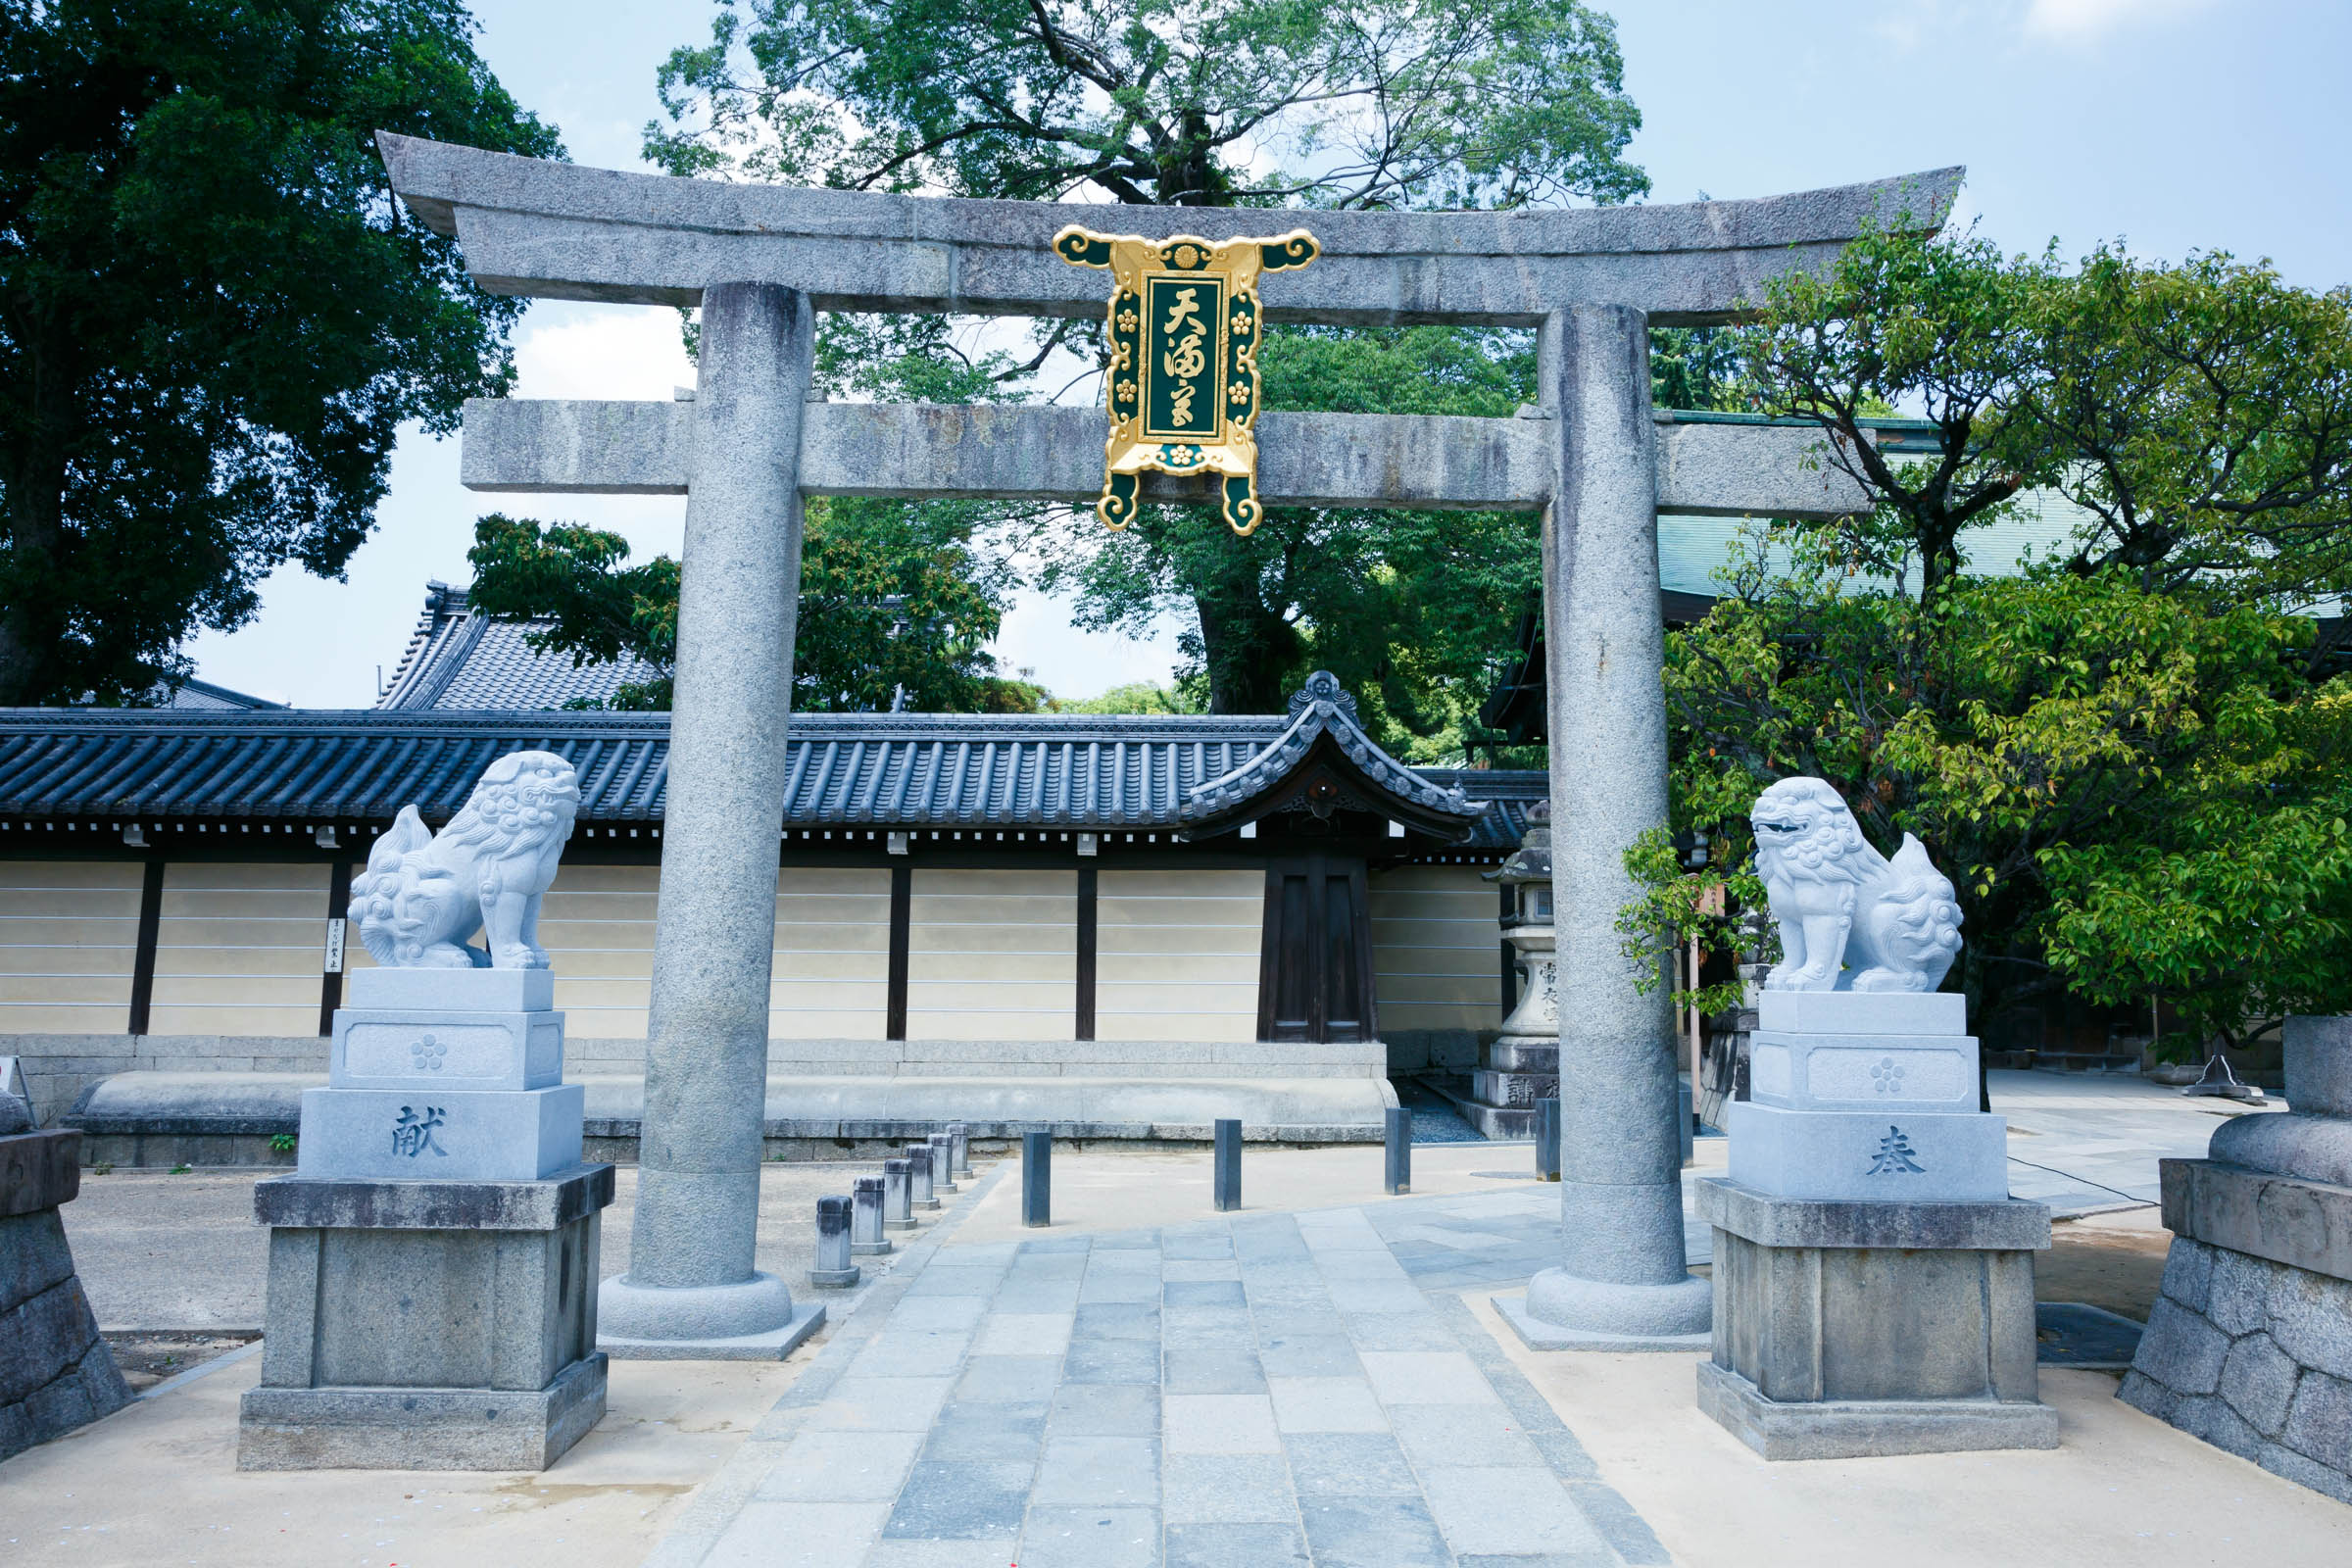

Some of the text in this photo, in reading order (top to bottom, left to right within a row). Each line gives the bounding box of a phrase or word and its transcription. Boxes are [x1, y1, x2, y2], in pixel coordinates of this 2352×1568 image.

[1163, 287, 1206, 427] 天満宮
[392, 1105, 448, 1157] 献
[1865, 1125, 1927, 1176] 奉
